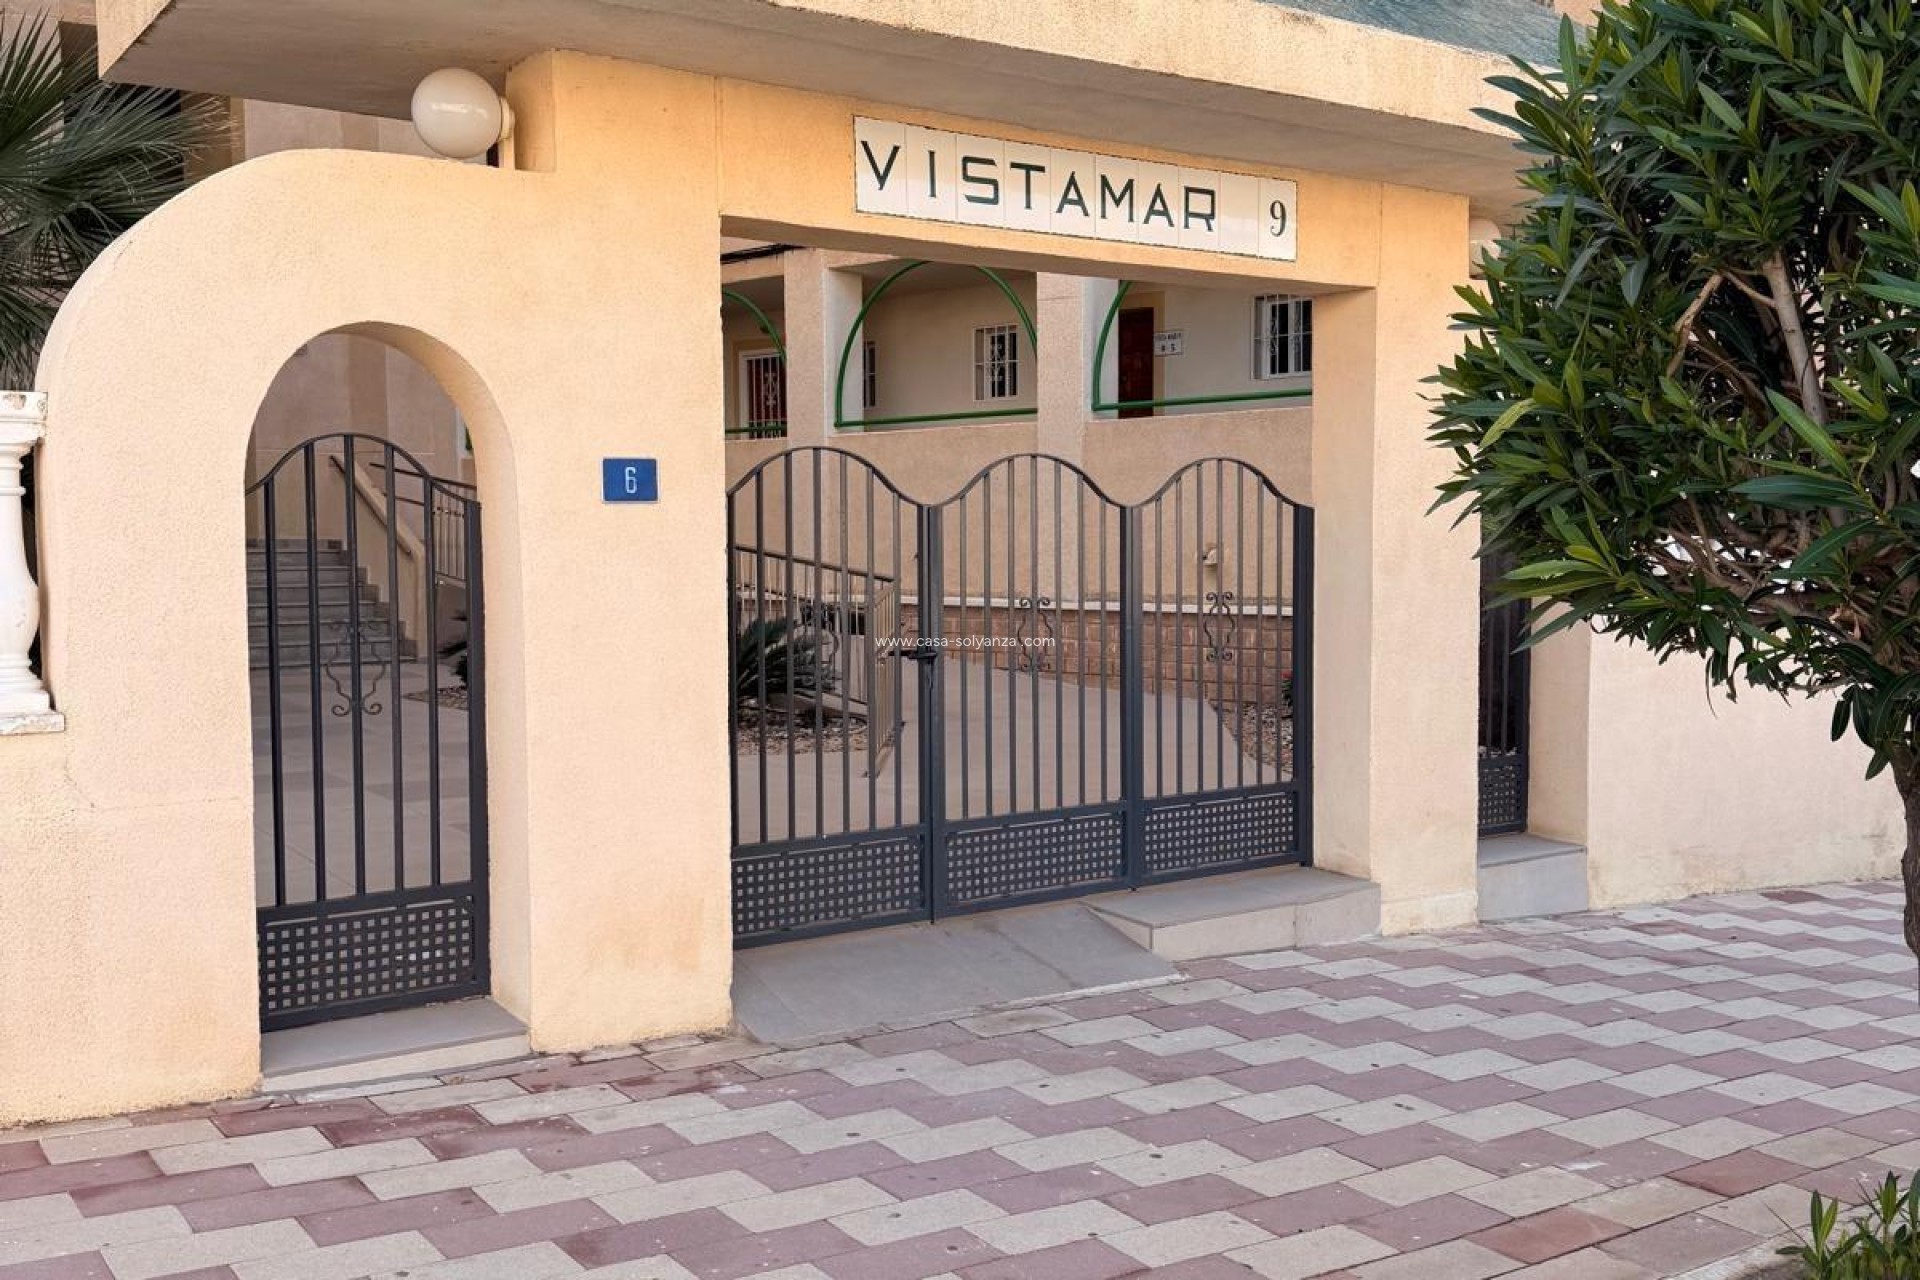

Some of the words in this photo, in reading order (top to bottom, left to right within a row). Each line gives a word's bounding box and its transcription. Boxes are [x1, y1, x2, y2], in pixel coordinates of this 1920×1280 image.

[861, 140, 1217, 232] VISTAMAR
[1269, 200, 1287, 238] 9
[625, 466, 637, 494] 6
